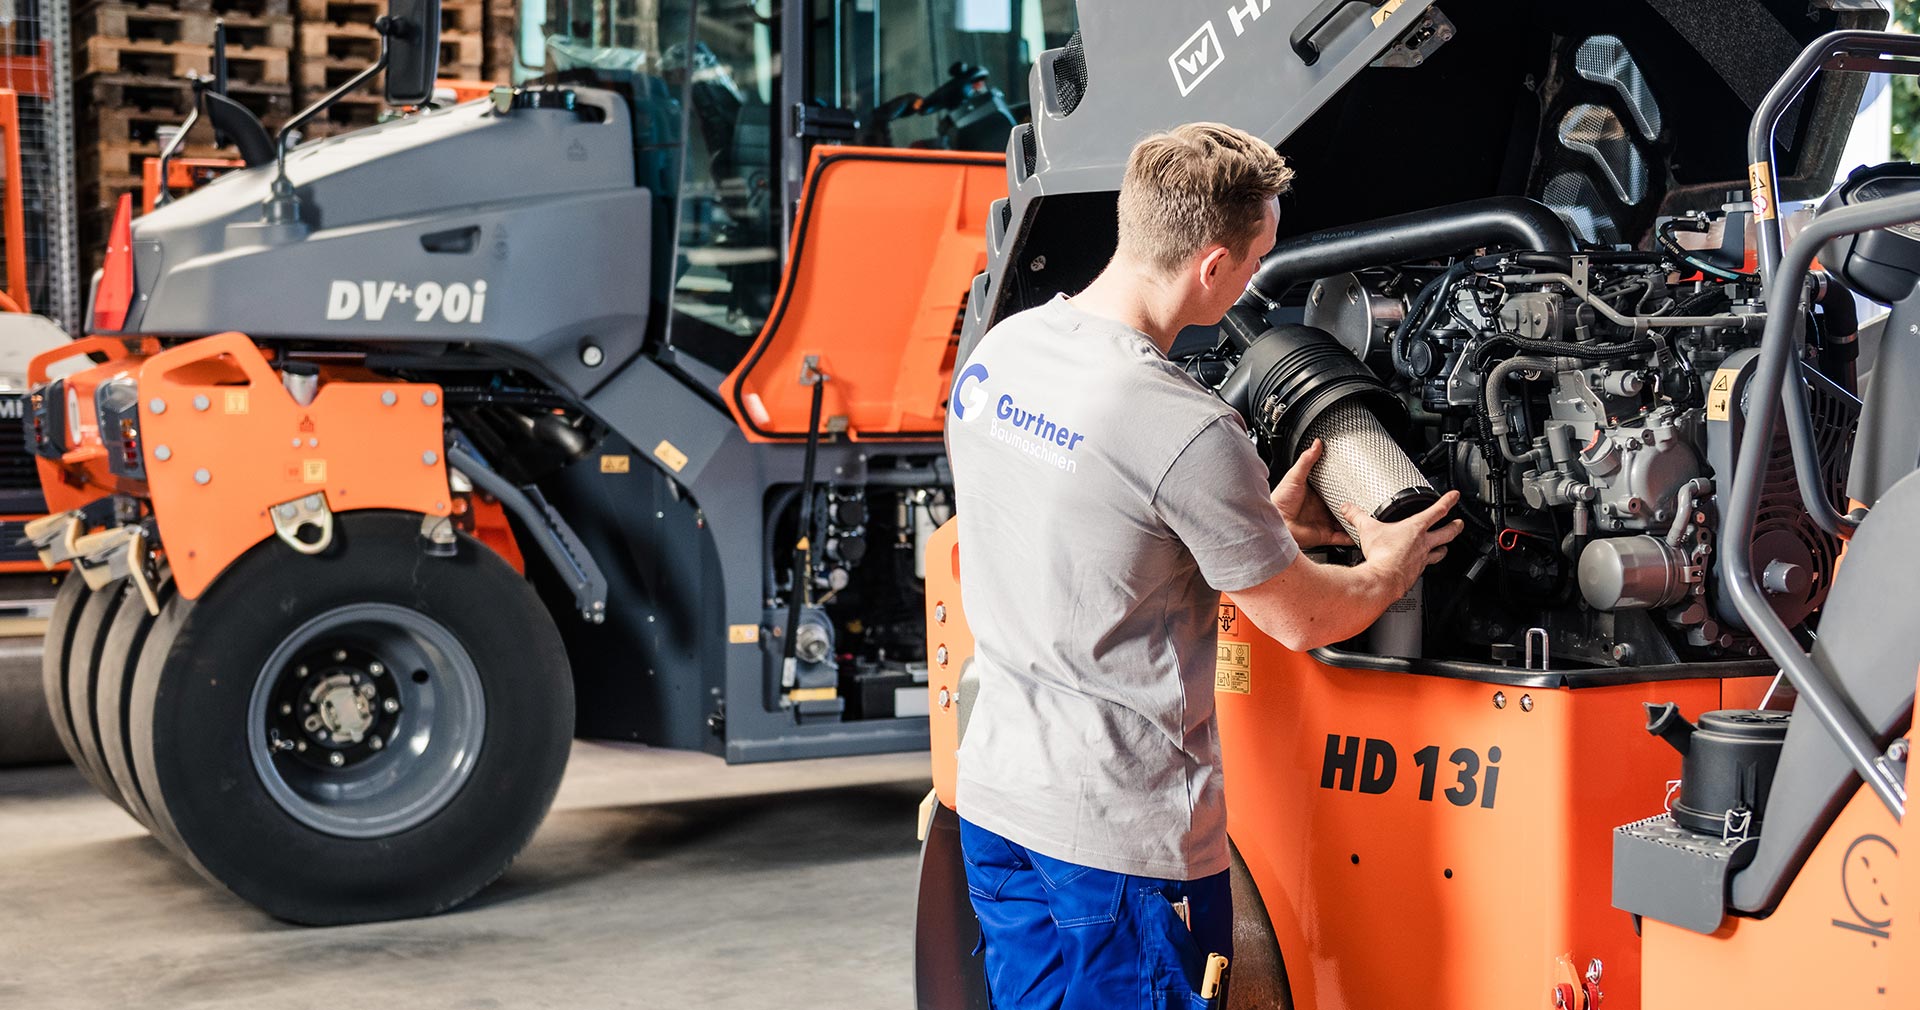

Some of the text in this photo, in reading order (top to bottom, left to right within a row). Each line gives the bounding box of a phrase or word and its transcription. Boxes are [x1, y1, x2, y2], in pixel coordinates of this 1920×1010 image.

[1227, 0, 1272, 37] H
[990, 418, 1078, 474] Baumaschinen
[996, 394, 1085, 451] Gurtner
[1320, 734, 1502, 809] HD 13i
